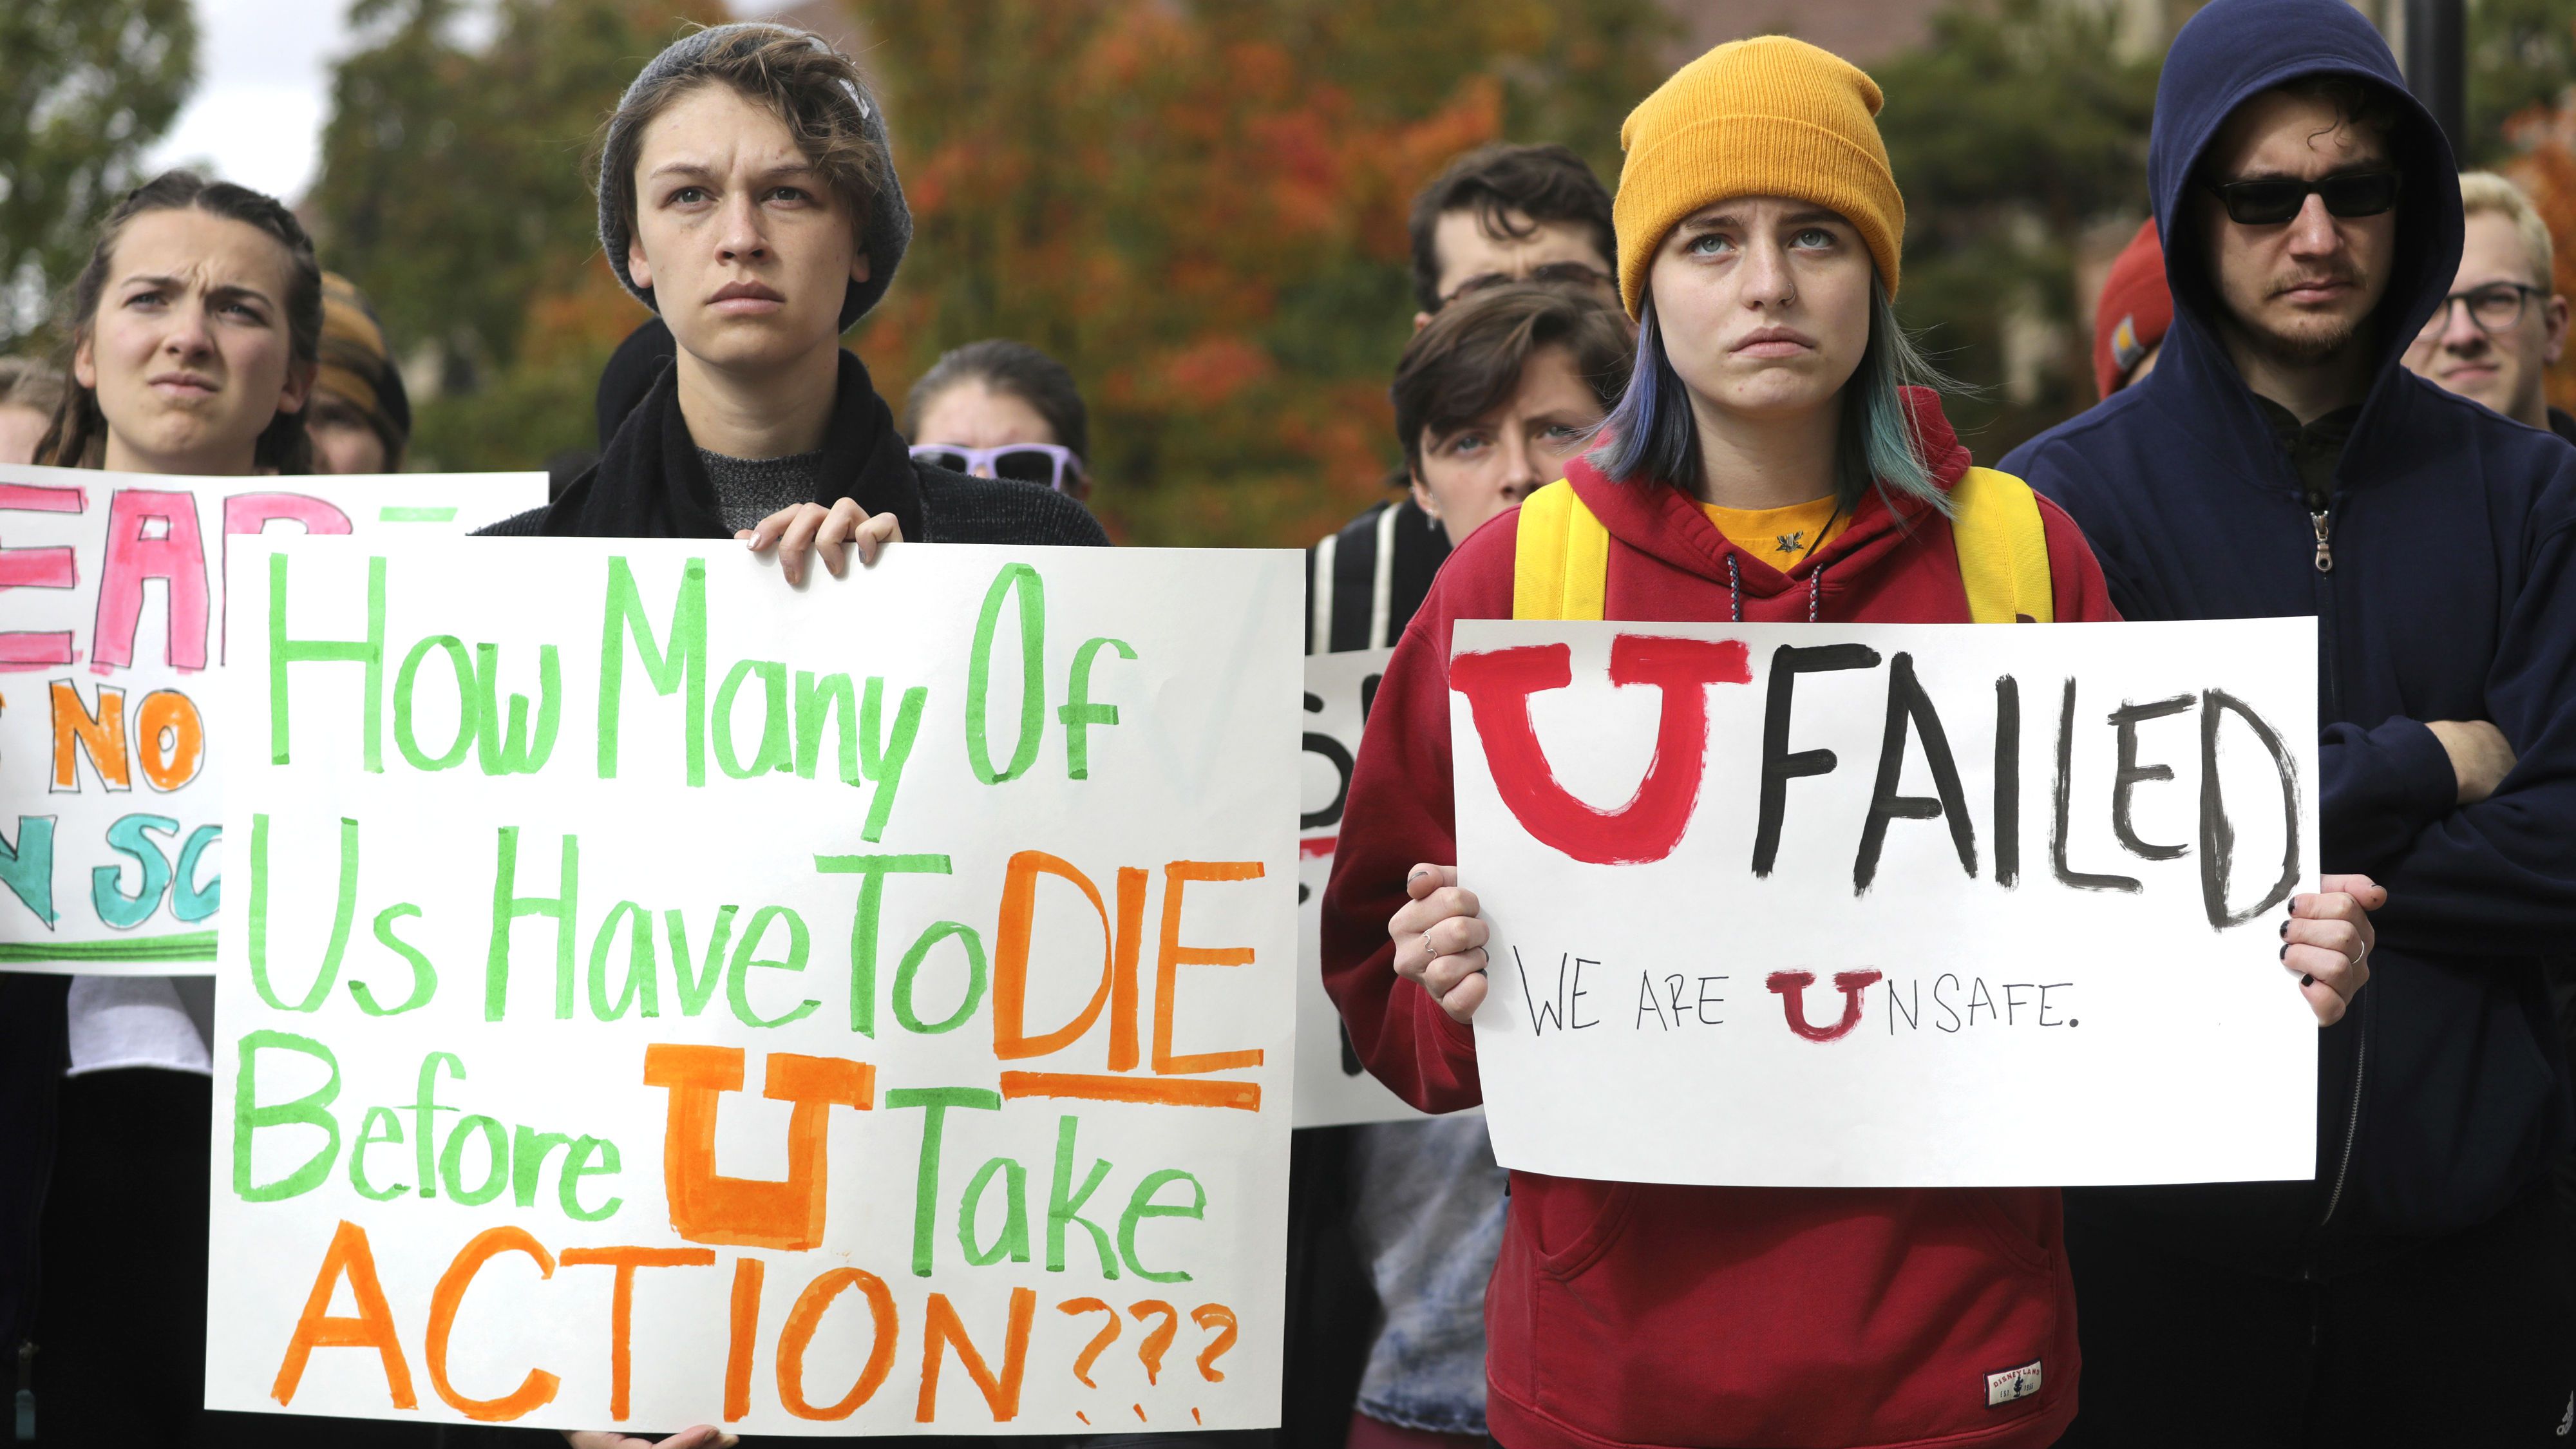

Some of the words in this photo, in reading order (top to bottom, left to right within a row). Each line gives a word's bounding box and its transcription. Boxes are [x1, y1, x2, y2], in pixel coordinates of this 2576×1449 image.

[49, 678, 205, 793] NO
[269, 553, 562, 775] How
[597, 556, 928, 843] Many
[965, 562, 1138, 786] Of
[1450, 633, 1753, 867] U
[1750, 643, 2301, 931] FAILED
[249, 813, 437, 1016] Us
[485, 826, 822, 1028] Have
[813, 853, 988, 1040] To
[993, 850, 1265, 1075] DIE
[1513, 945, 1601, 1037] WE
[1636, 969, 1729, 1031] ARE
[1764, 965, 2079, 1043] UNSAFE.
[232, 1029, 623, 1222] Before
[643, 1043, 876, 1253] U
[885, 1087, 1208, 1283] Take
[1993, 1368, 2040, 1388] DISNEYLAND
